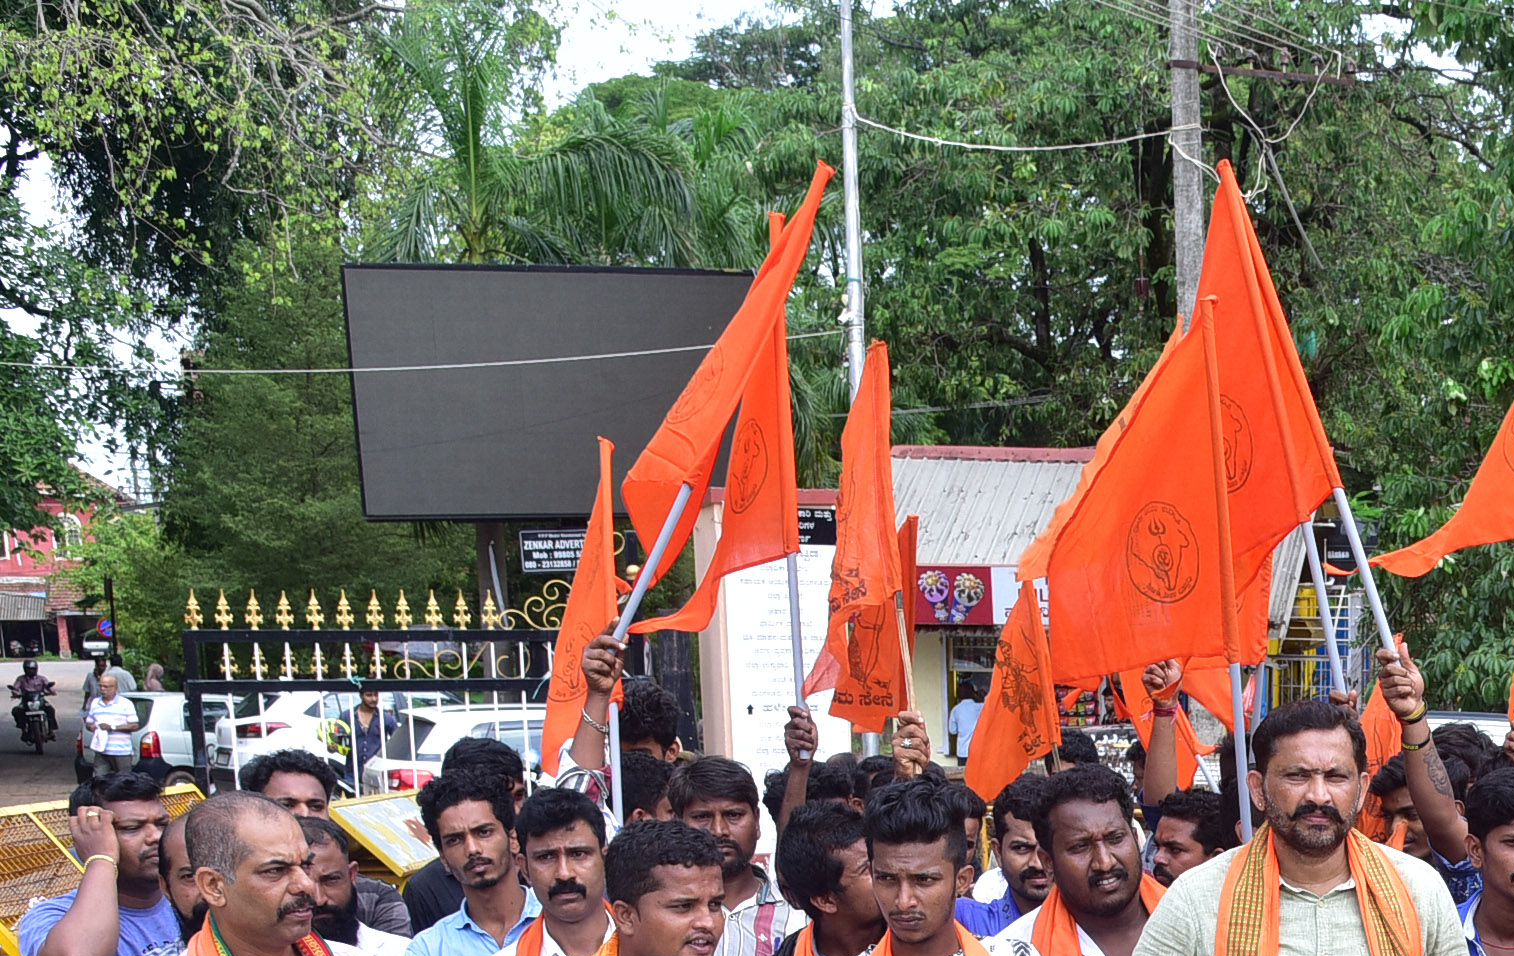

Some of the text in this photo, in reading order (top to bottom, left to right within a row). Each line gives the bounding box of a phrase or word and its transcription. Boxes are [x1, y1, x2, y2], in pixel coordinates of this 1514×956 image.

[523, 540, 553, 550] ZENKAR
[532, 551, 548, 559] Mob
[859, 692, 894, 708] ಸೇನೆ
